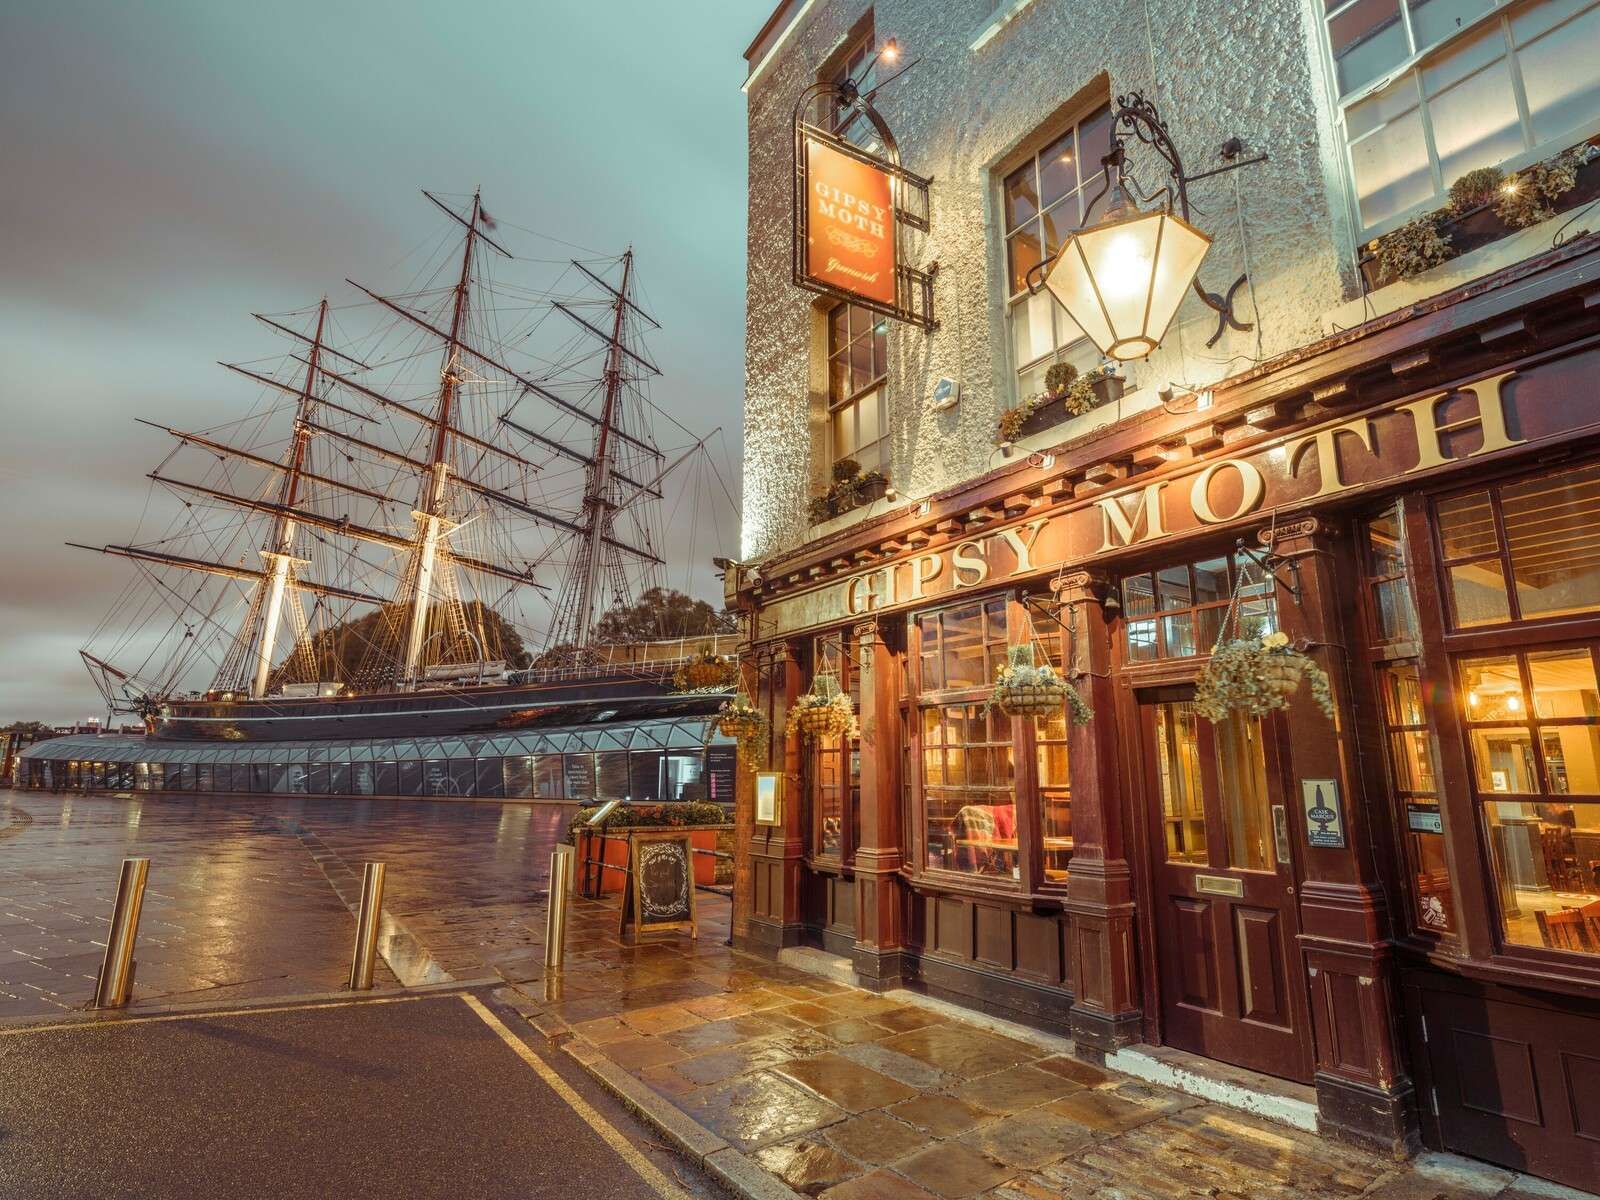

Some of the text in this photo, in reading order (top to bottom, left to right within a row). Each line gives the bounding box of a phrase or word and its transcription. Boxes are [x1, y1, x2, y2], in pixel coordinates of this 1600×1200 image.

[815, 181, 887, 221] GIPSY
[818, 200, 885, 239] MOTH
[847, 371, 1528, 616] GIPSY MOTH
